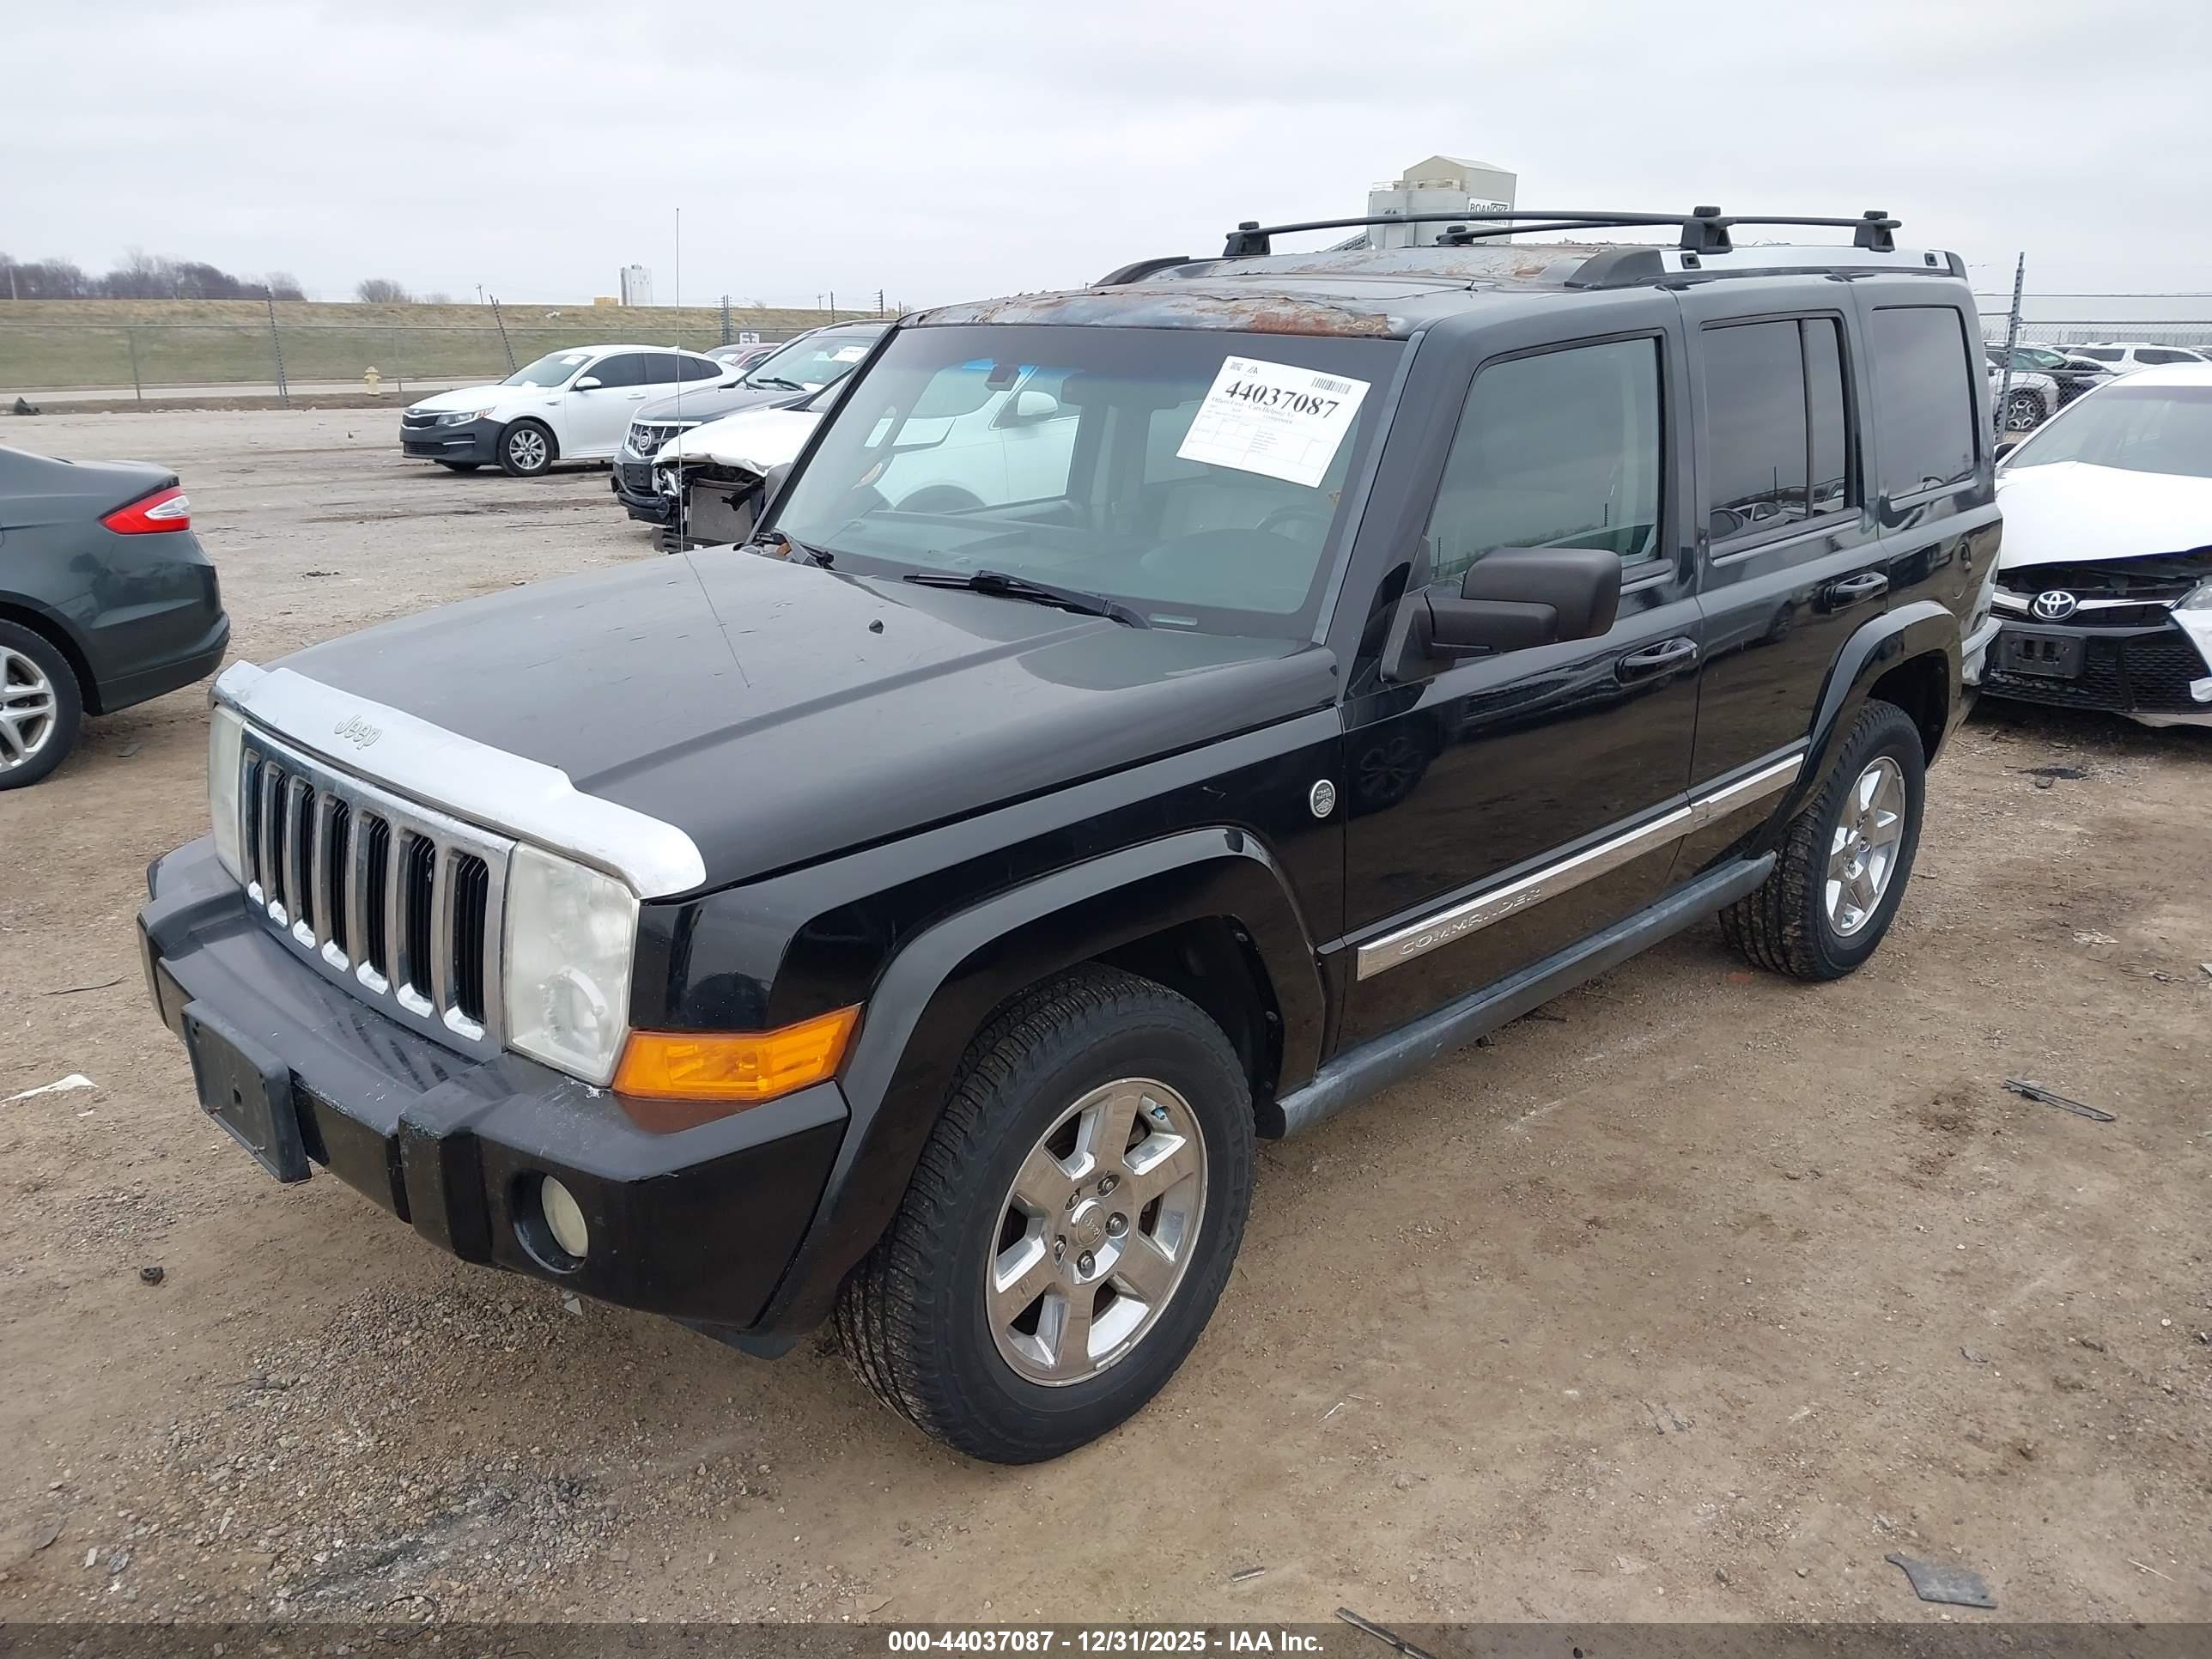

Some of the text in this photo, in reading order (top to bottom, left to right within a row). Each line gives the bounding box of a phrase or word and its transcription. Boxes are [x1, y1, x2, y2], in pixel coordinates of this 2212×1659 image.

[1225, 380, 1340, 419] 44037087
[334, 714, 382, 750] Jeep
[1400, 888, 1540, 955] COMMANDER
